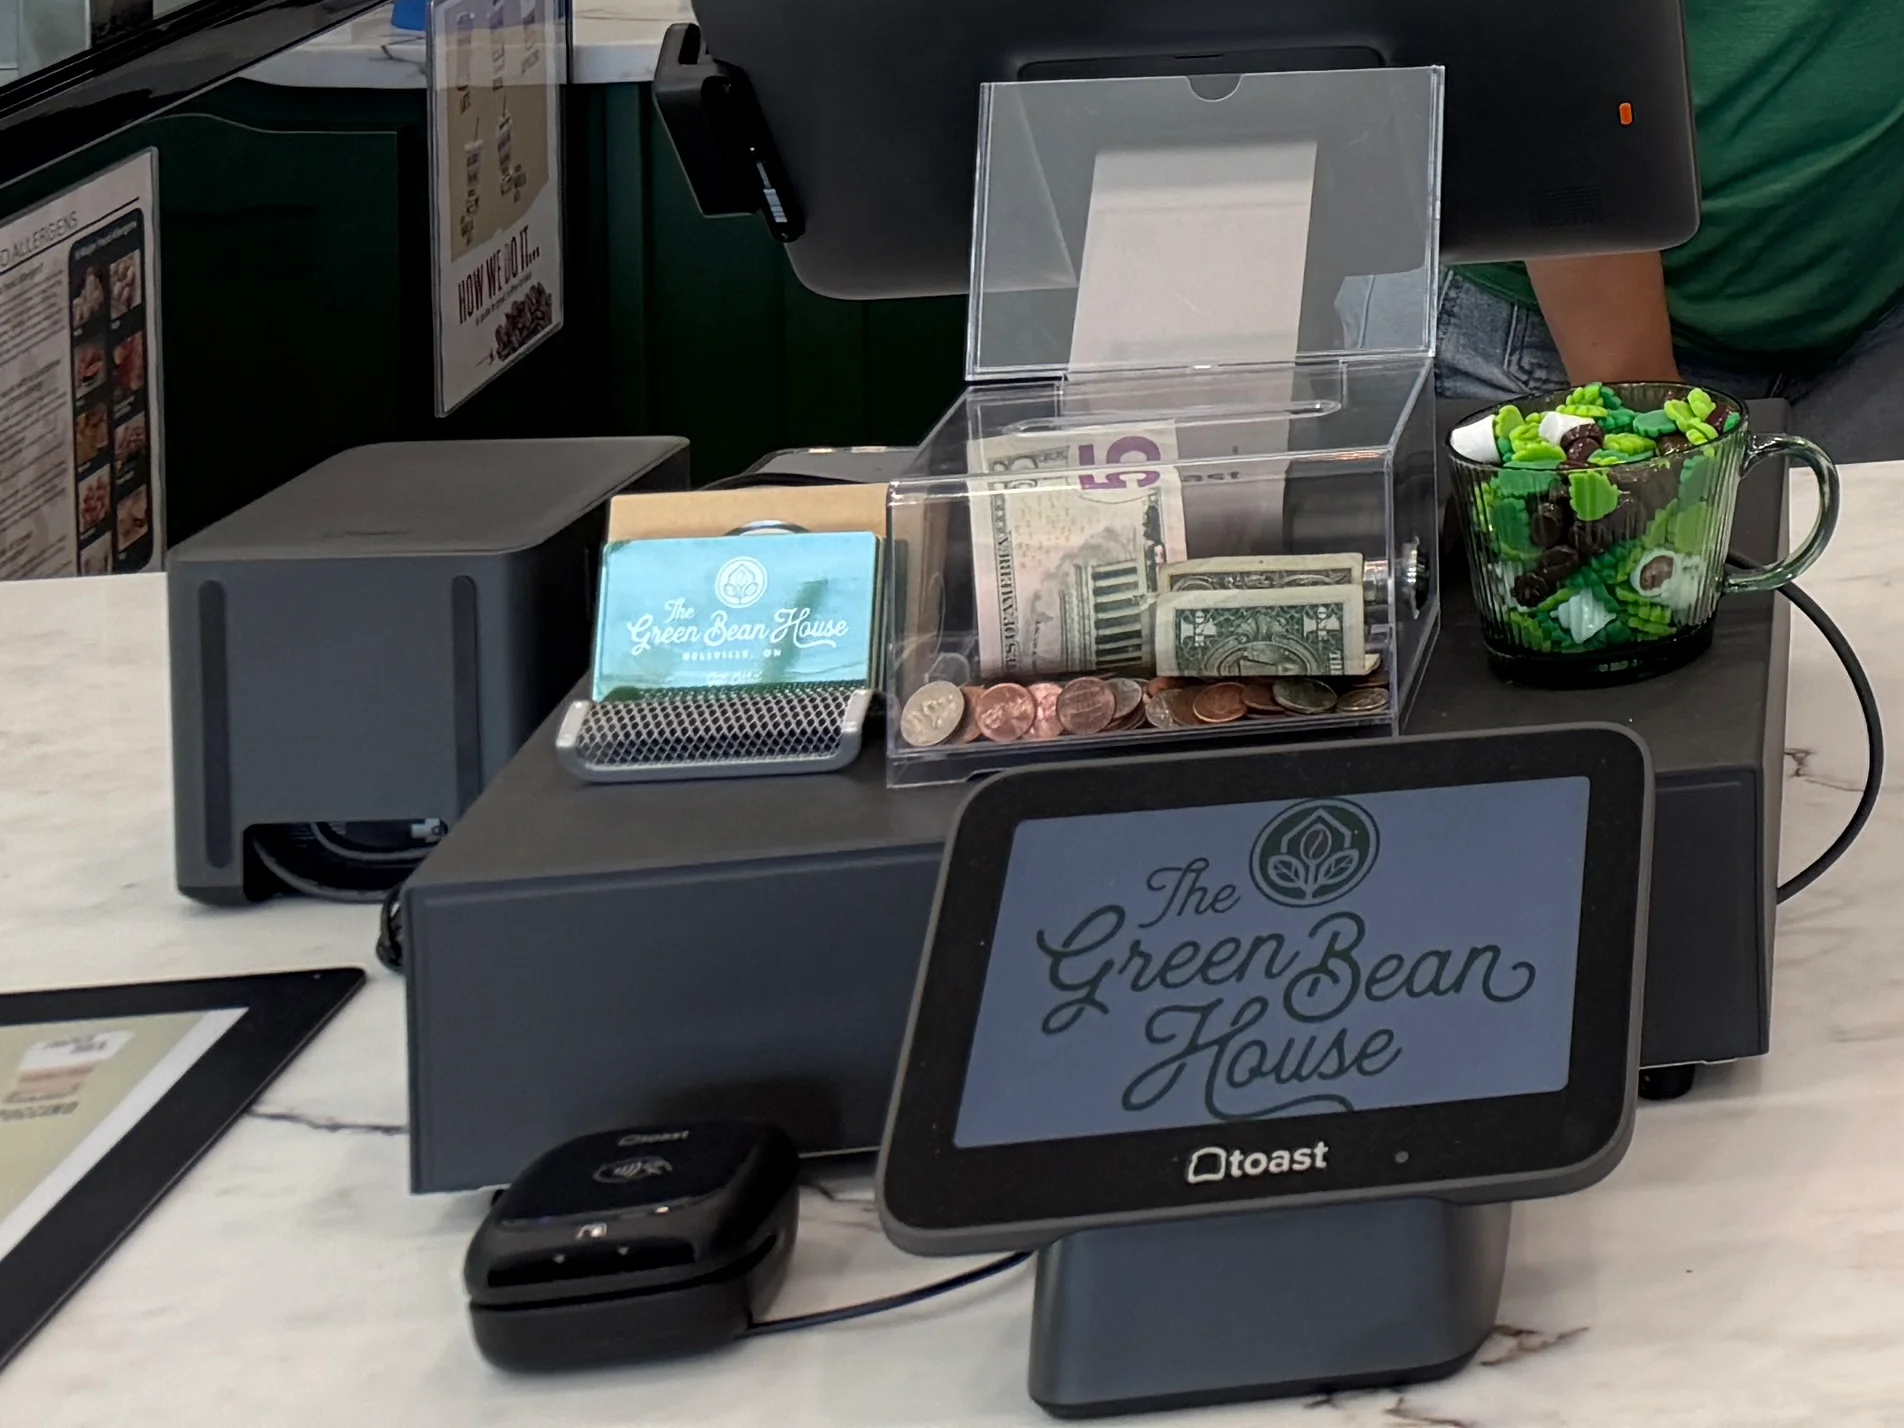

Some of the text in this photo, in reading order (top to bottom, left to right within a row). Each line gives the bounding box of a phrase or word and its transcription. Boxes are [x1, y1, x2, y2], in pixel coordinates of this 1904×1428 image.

[458, 263, 484, 326] HOW
[486, 248, 502, 301] WE
[626, 607, 849, 656] Green Bean House
[664, 596, 695, 624] The
[1137, 857, 1241, 928] The
[1037, 904, 1536, 1036] Green Bean
[1121, 997, 1403, 1121] House
[1228, 1140, 1329, 1178] toast
